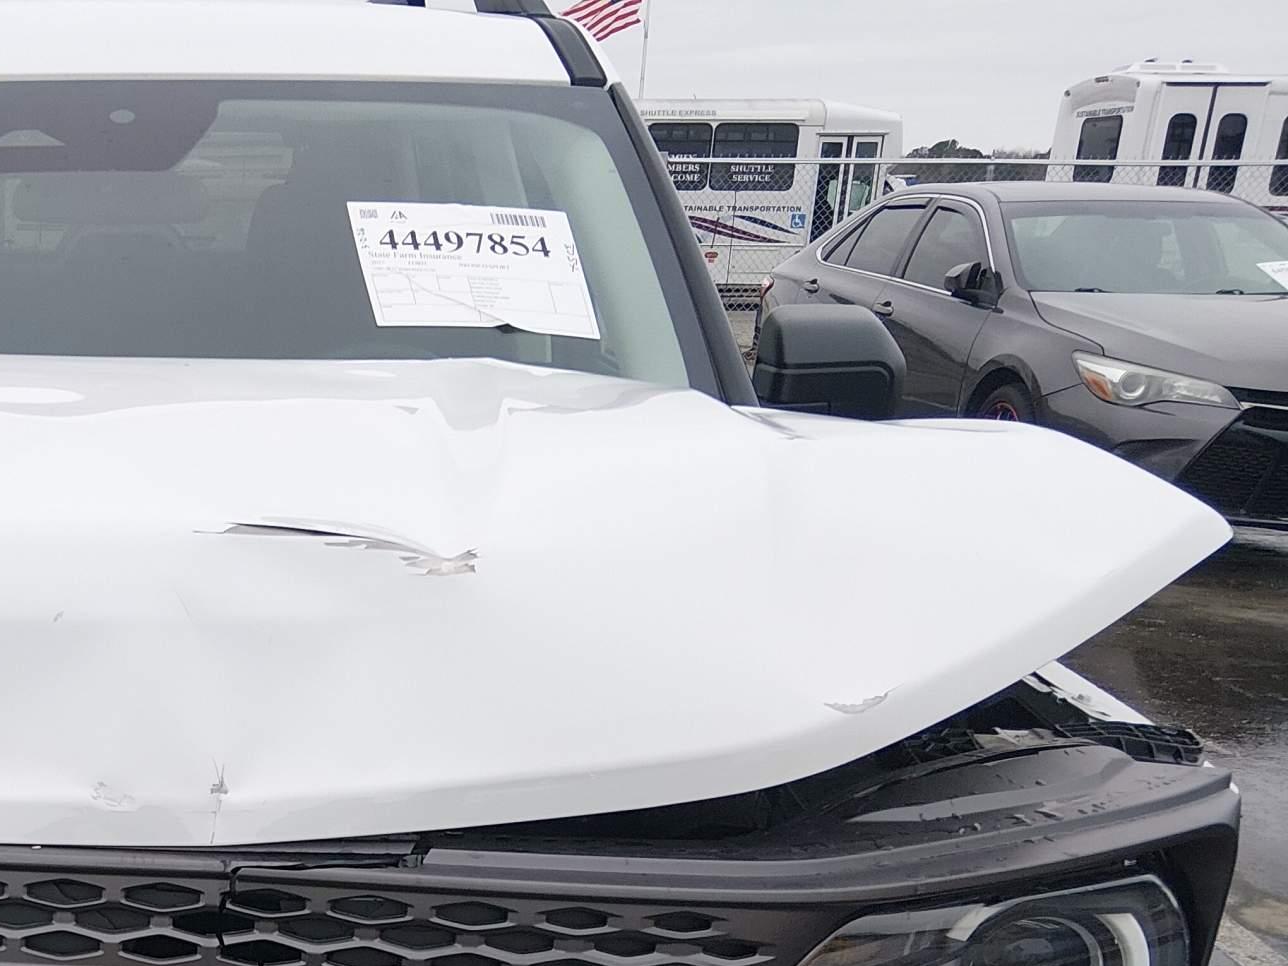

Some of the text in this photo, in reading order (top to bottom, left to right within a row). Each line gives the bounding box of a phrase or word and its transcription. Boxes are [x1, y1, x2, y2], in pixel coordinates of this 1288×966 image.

[667, 163, 700, 172] MBERS
[671, 173, 701, 182] COME
[732, 174, 771, 182] SERVICE
[684, 205, 802, 213] TAINABLE TRANSPORTATION
[379, 228, 551, 258] 44497854
